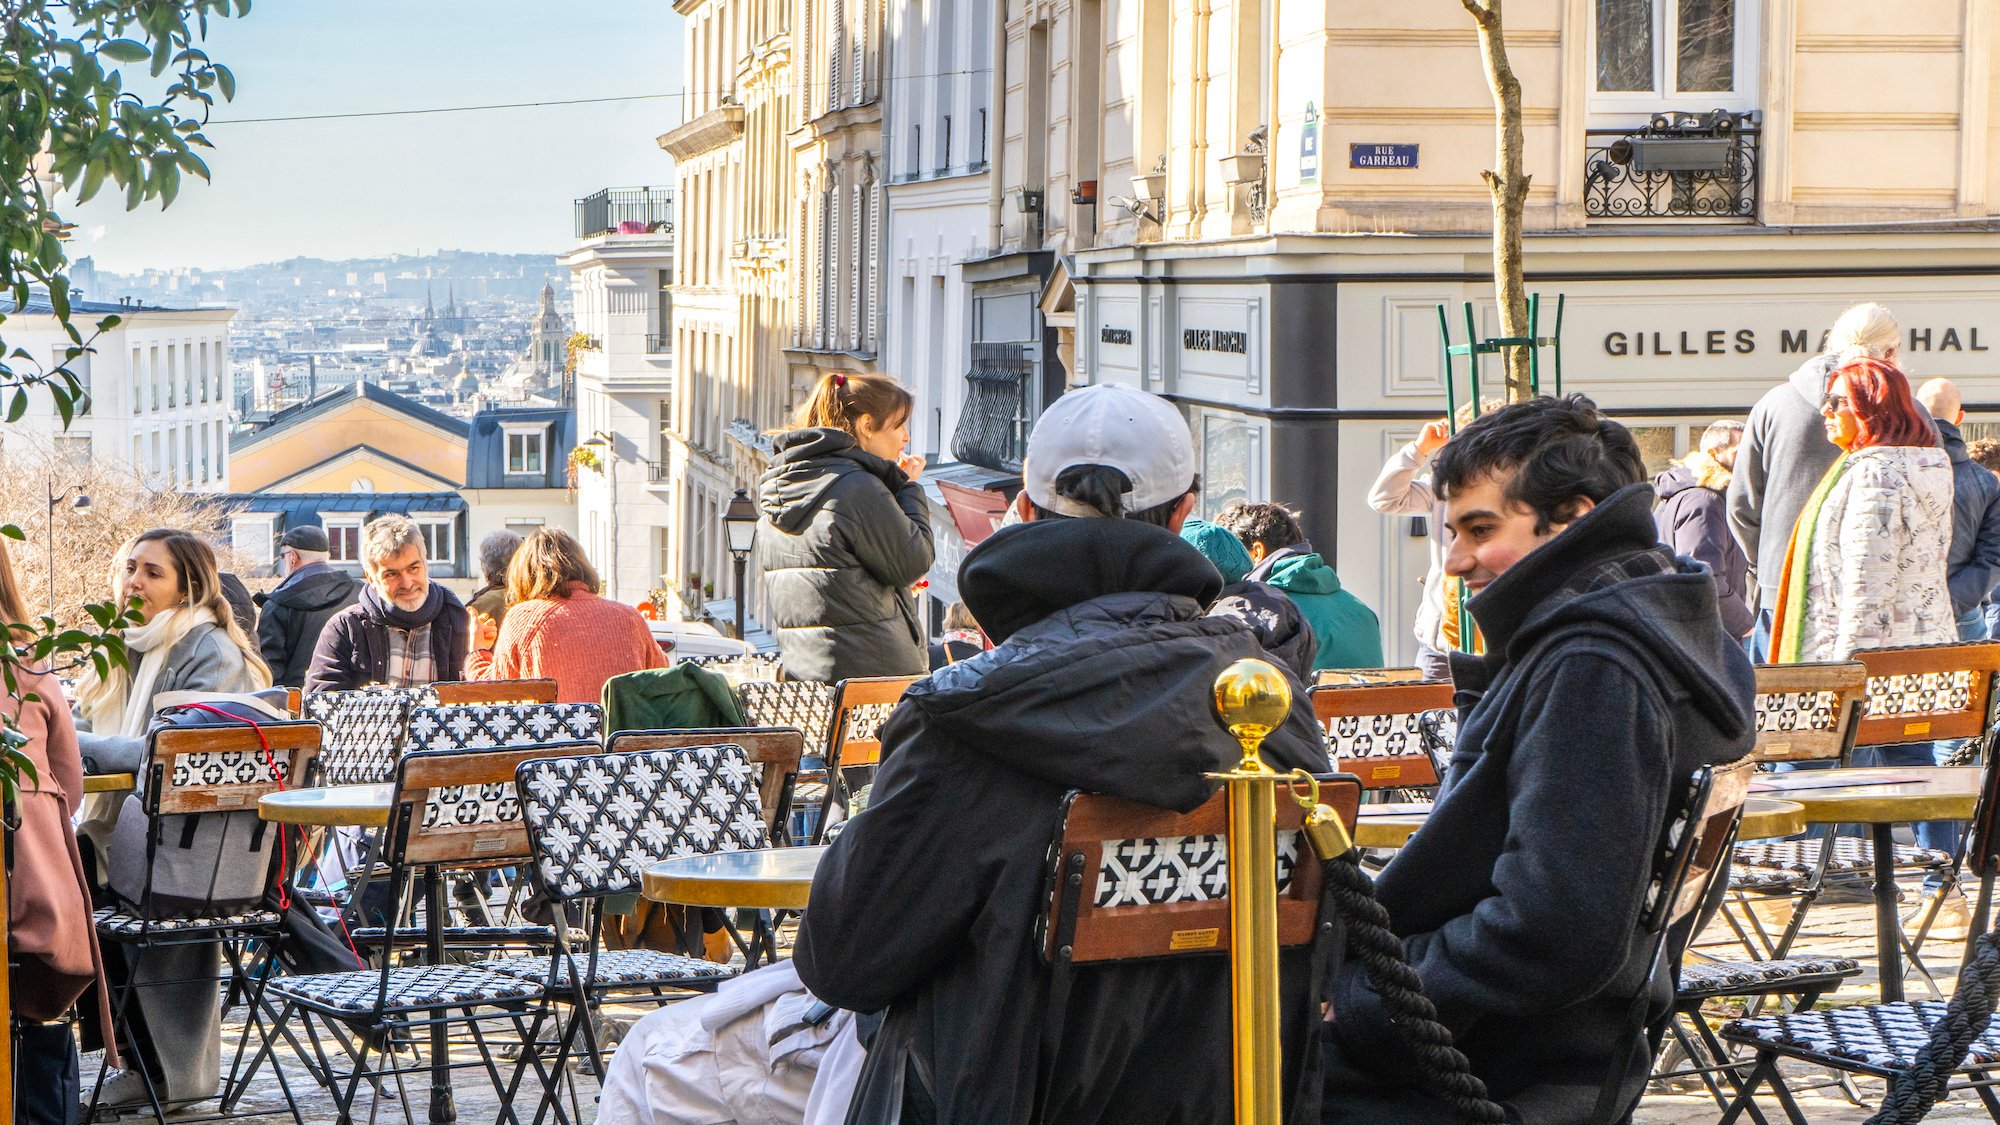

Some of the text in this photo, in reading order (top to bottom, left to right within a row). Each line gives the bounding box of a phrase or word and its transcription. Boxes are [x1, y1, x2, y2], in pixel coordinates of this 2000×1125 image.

[1375, 146, 1394, 155] RUE
[1360, 156, 1410, 166] GARREAU
[1184, 328, 1211, 351] GILLES
[1605, 327, 1989, 356] GILLES MHAL
